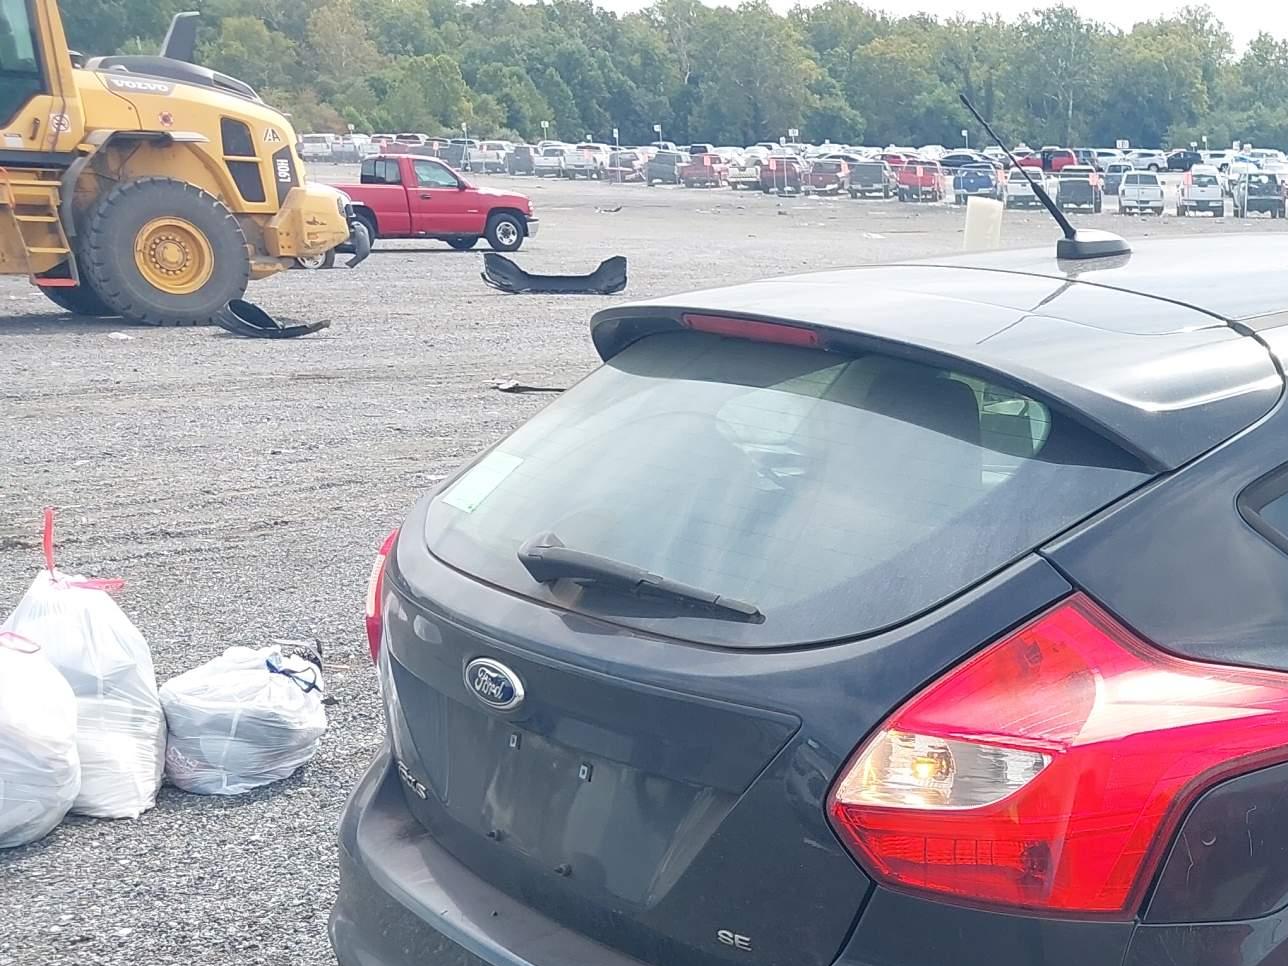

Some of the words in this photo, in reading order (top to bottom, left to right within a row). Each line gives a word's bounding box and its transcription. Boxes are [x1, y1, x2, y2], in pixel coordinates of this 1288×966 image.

[112, 80, 169, 92] VOLVO
[276, 159, 292, 183] L90H
[474, 667, 506, 699] Ford
[717, 929, 753, 951] SE
